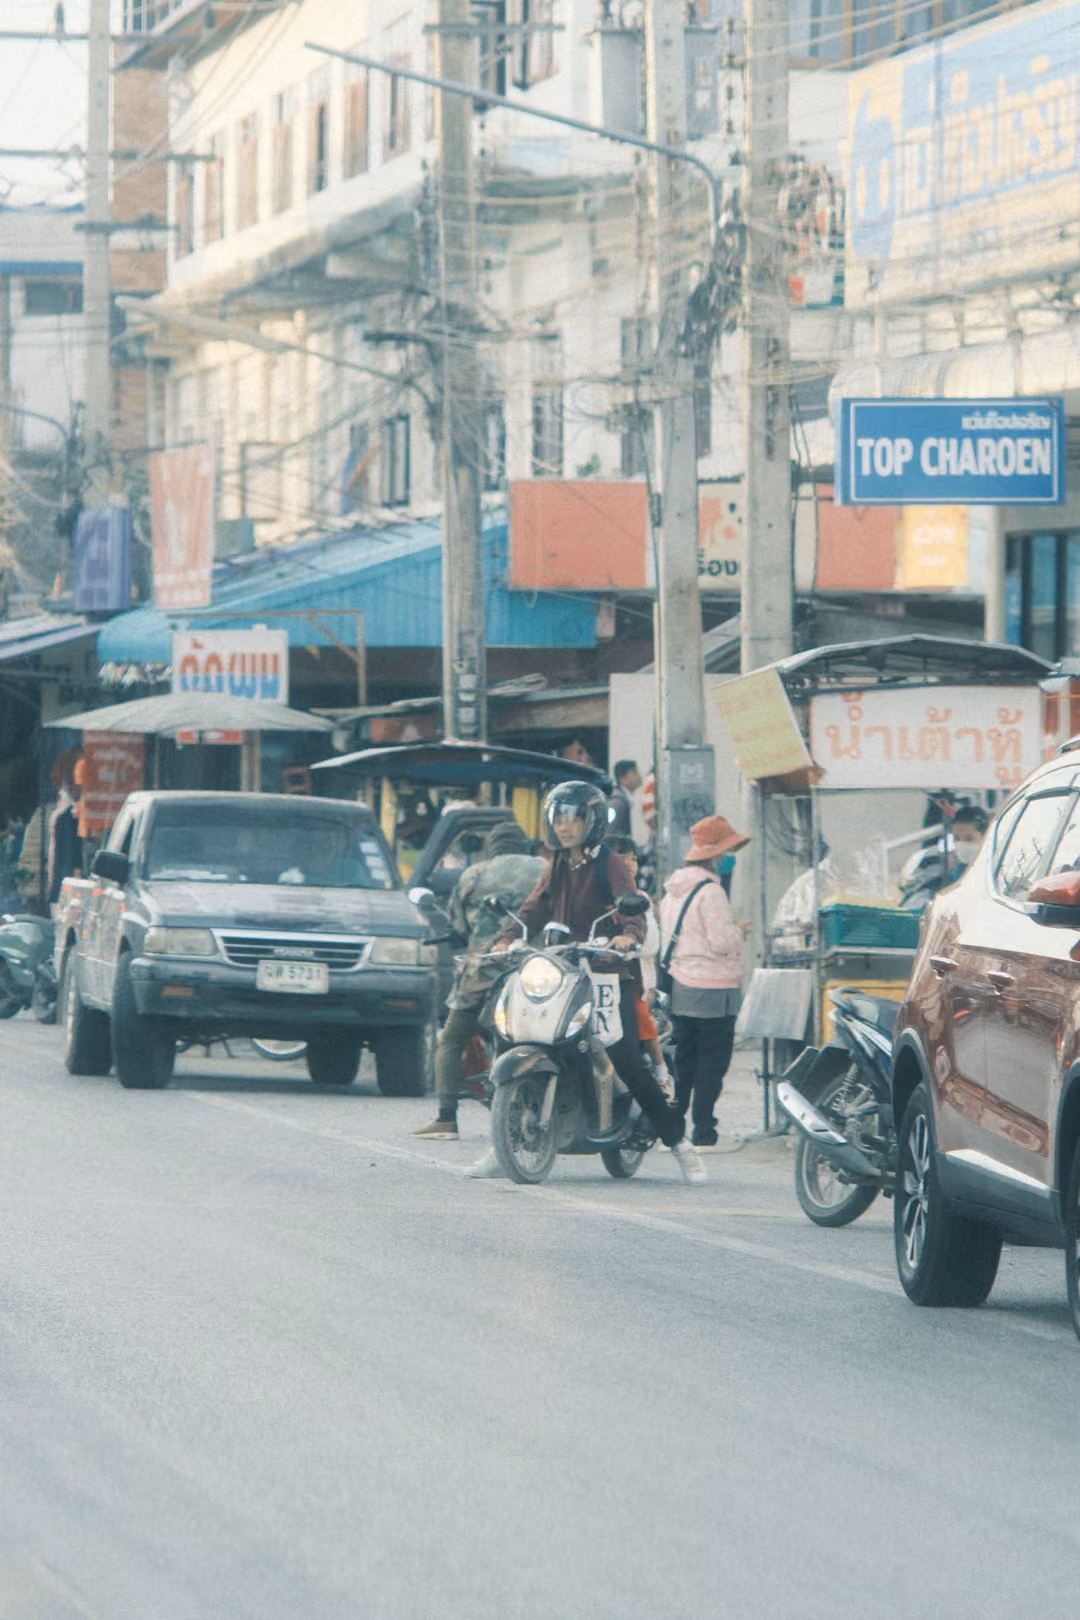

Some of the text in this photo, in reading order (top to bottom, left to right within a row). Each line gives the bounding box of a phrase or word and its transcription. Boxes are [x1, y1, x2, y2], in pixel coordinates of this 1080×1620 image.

[856, 436, 1052, 477] TOP CHAROEN
[596, 984, 614, 1009] E
